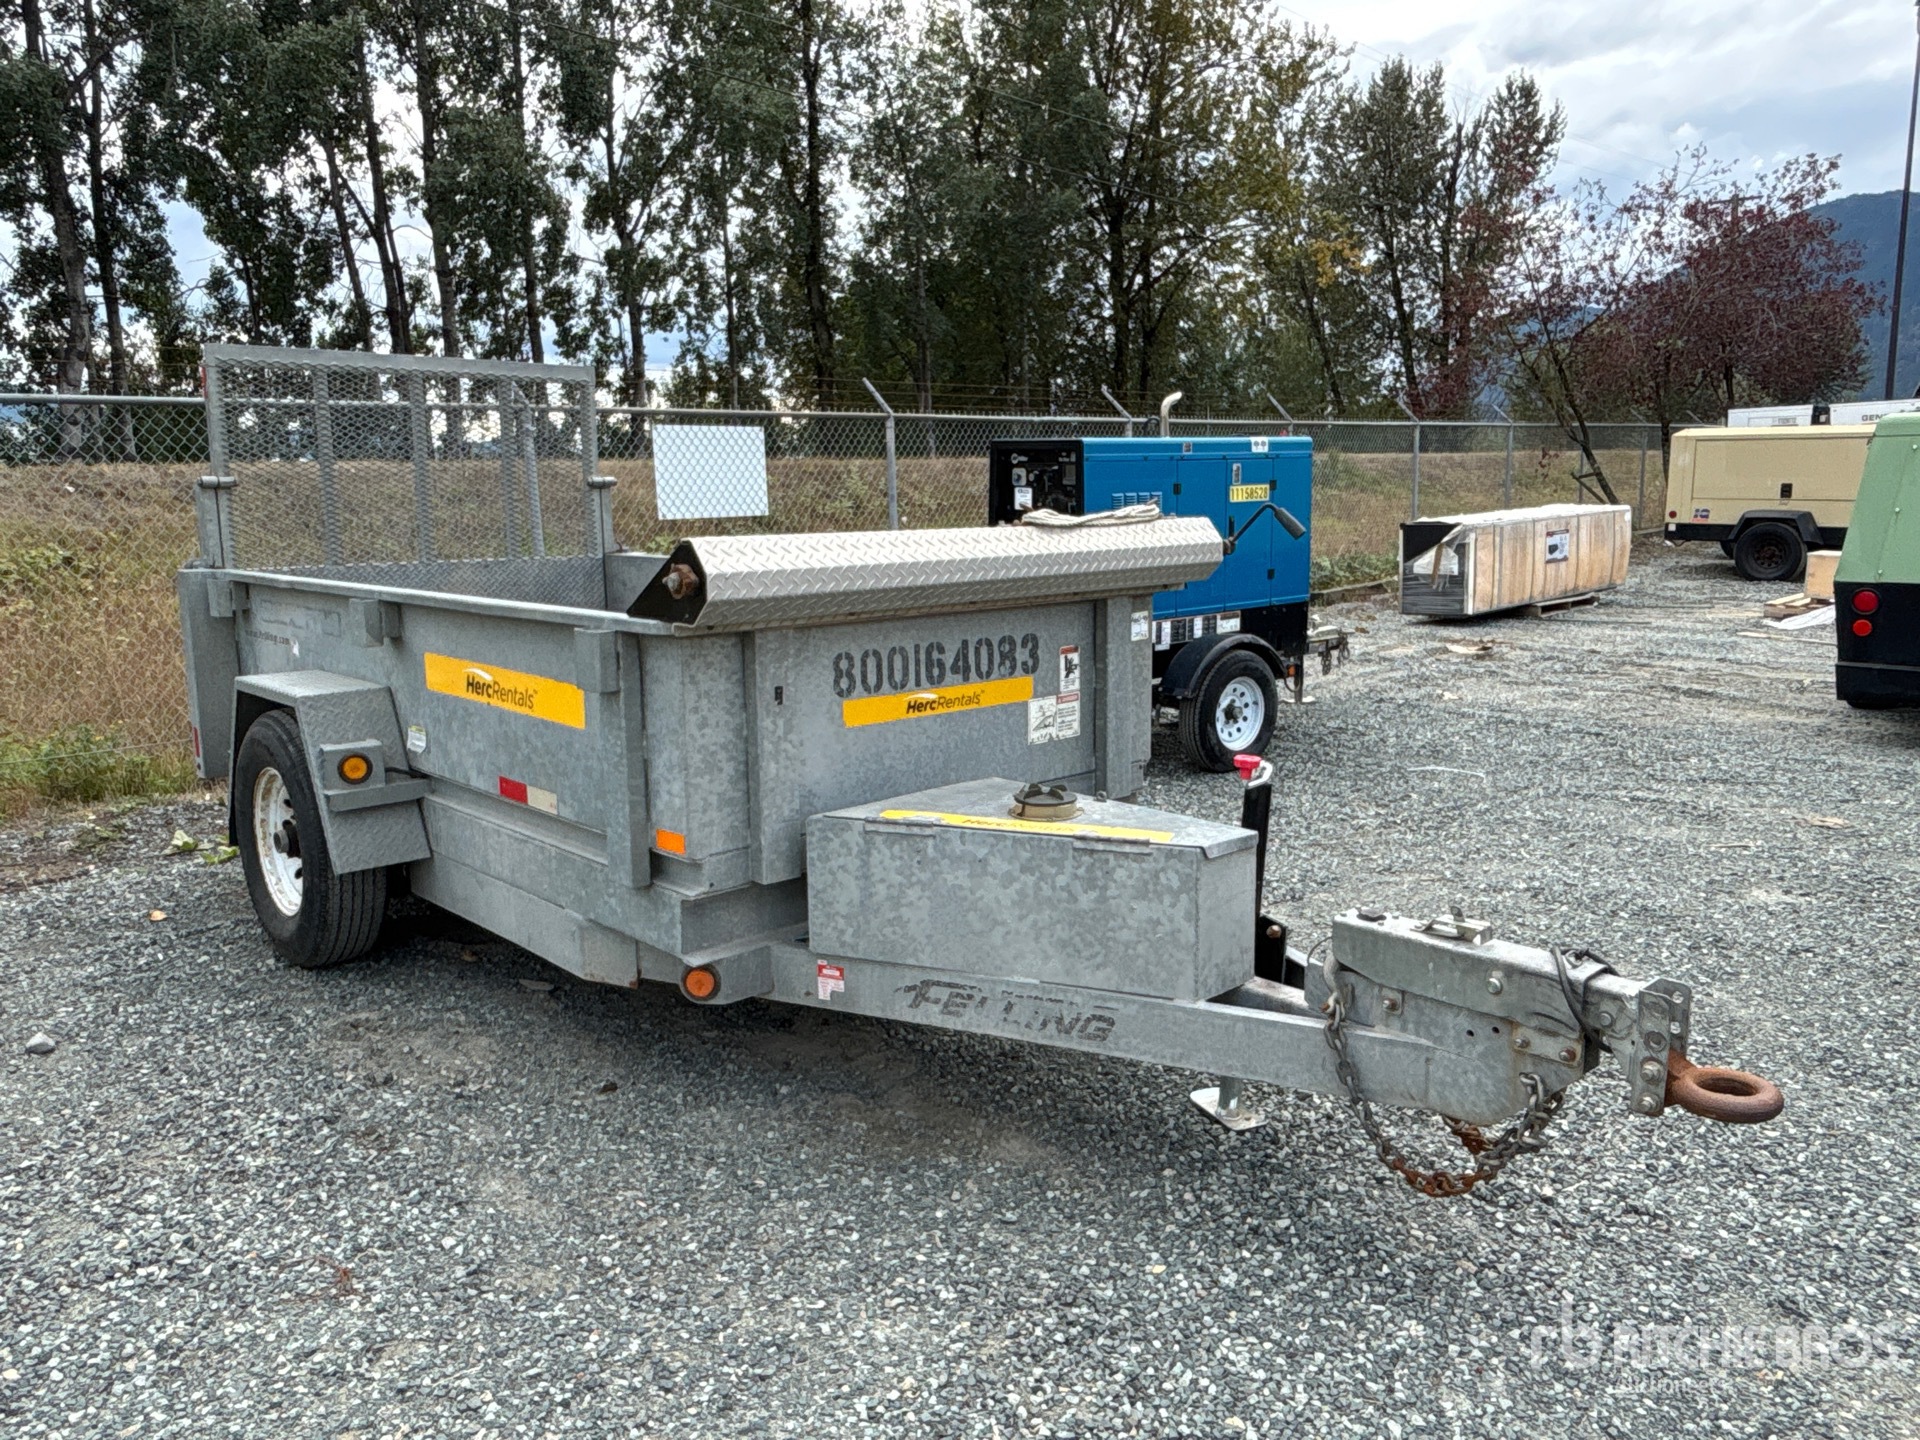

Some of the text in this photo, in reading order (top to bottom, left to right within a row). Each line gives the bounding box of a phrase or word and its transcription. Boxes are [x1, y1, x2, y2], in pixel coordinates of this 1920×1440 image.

[1861, 413, 1888, 422] GEN
[1231, 486, 1268, 501] 11158528
[832, 632, 1040, 698] 800164083
[897, 978, 1118, 1042] FELNG
